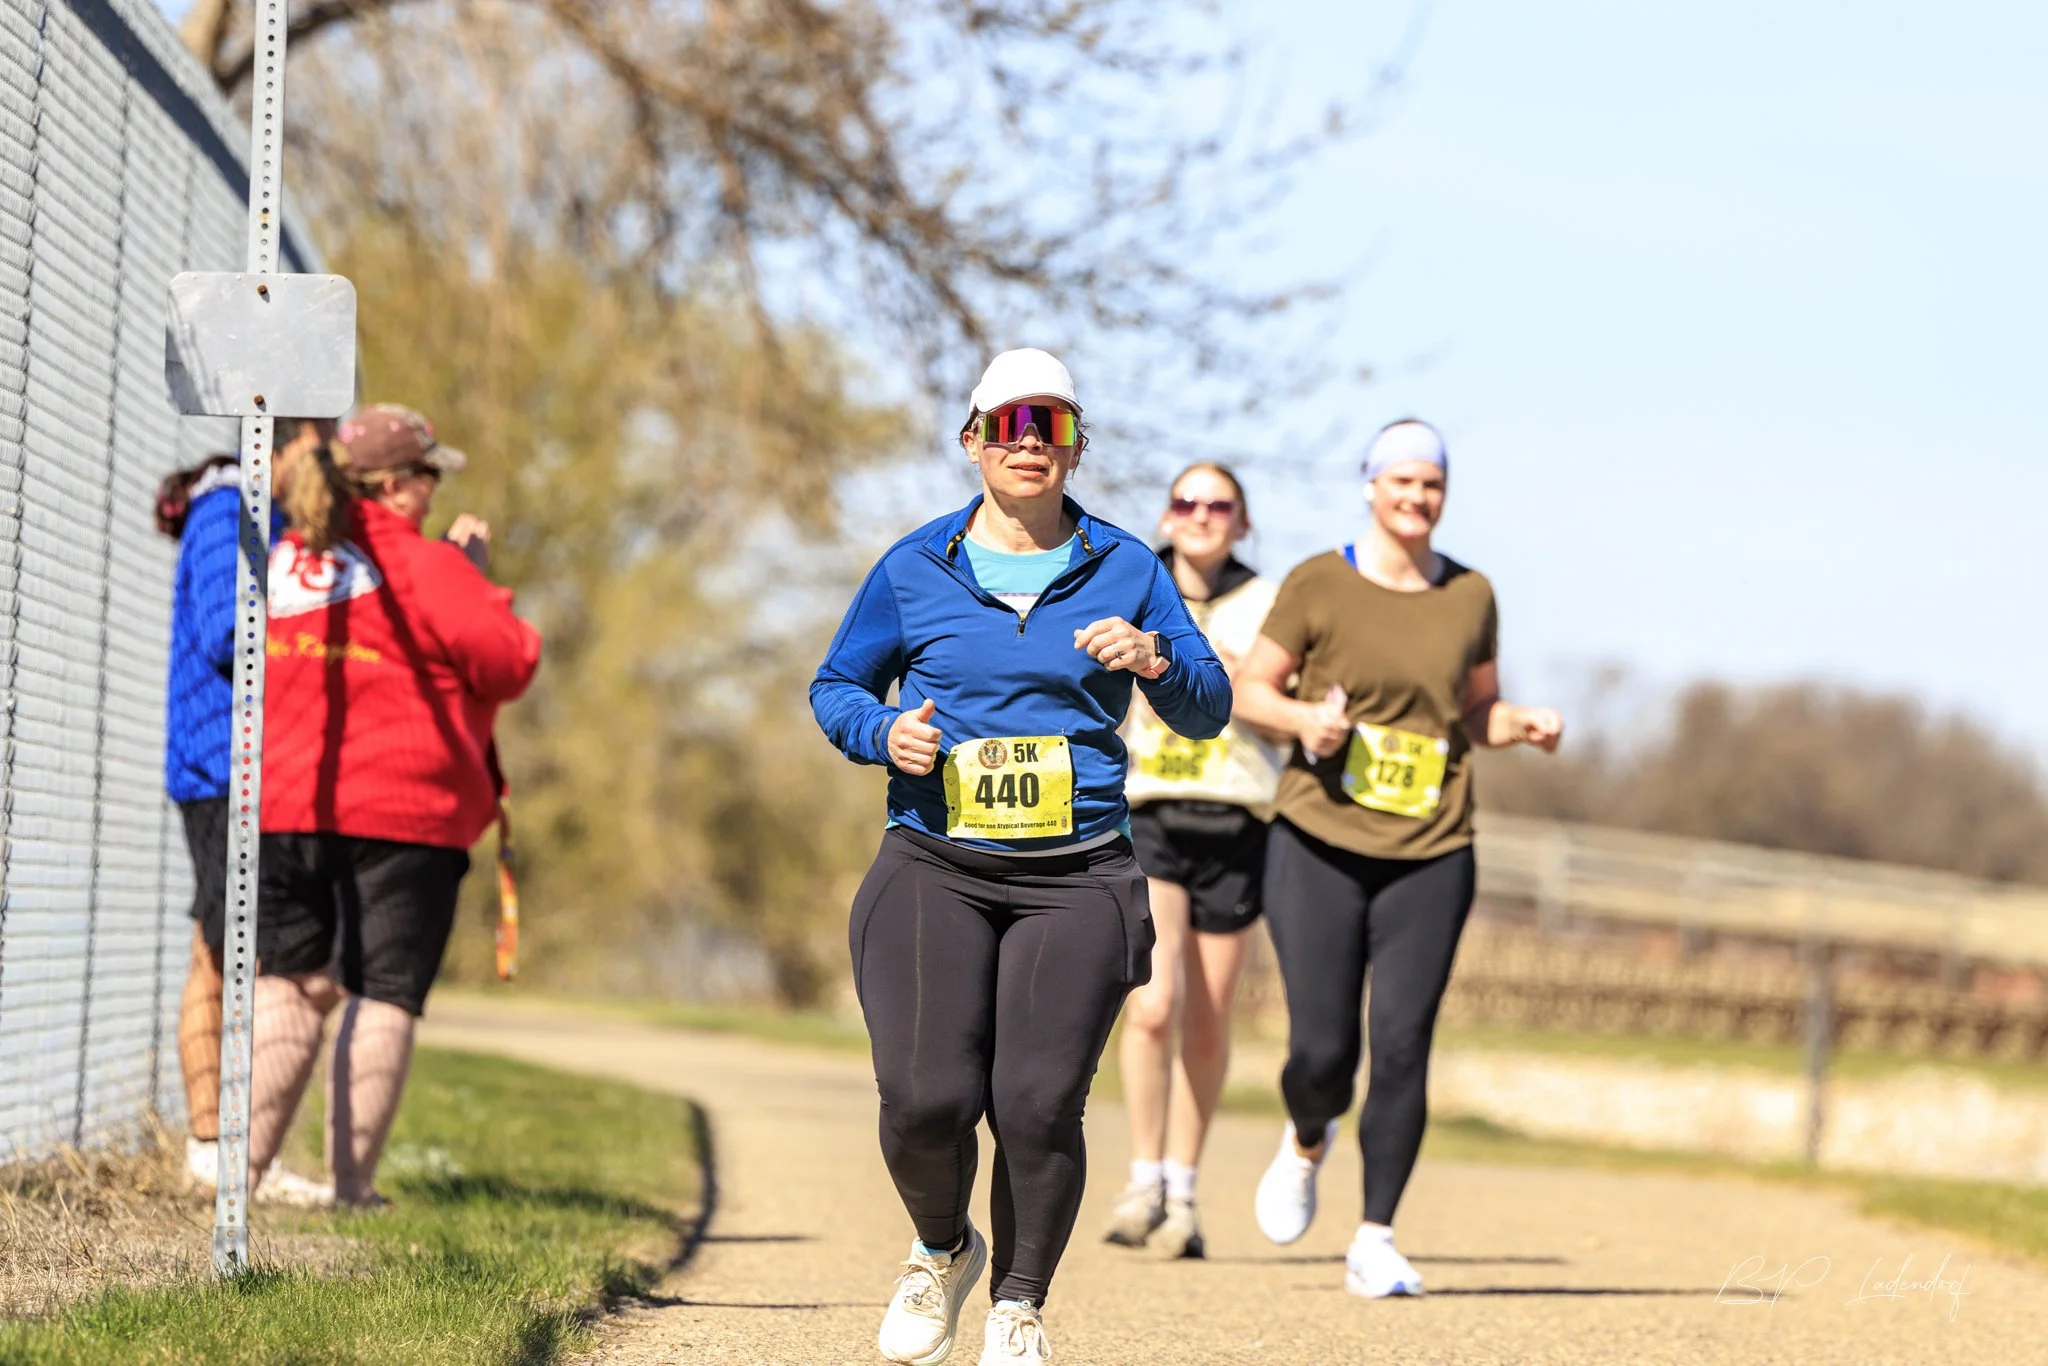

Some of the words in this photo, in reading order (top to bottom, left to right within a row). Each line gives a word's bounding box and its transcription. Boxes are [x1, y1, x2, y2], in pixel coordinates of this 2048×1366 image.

[1014, 743, 1038, 763] 5K
[1377, 759, 1415, 787] 128
[975, 772, 1040, 809] 440
[997, 822, 1019, 830] Atypical
[1020, 821, 1045, 829] Beverage
